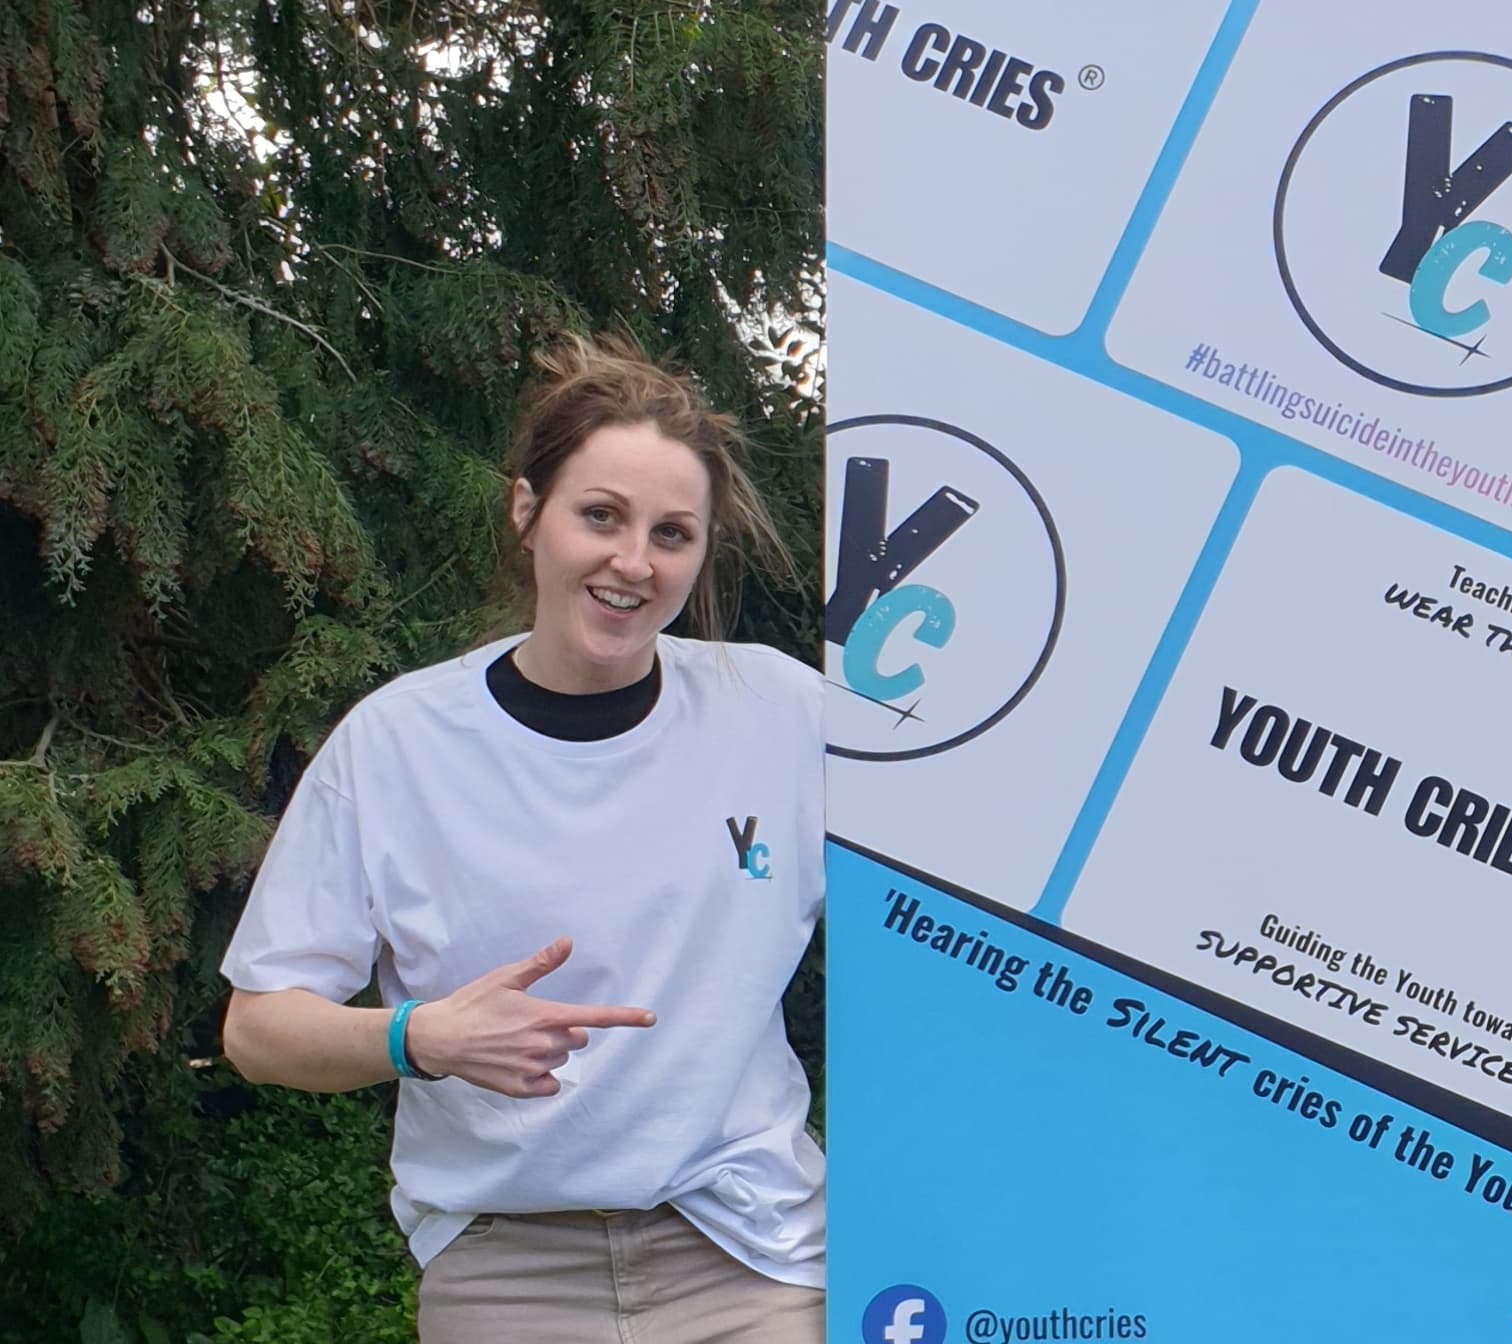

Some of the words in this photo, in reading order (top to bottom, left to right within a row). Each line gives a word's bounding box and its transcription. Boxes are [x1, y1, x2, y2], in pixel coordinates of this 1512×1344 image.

[901, 22, 1065, 130] CRIES
[1384, 583, 1473, 638] WEAR
[1209, 686, 1402, 817] YOUTH
[1196, 929, 1389, 1025] SUPPORTIVE
[1260, 913, 1346, 972] Guiding
[1351, 952, 1388, 986] the
[1394, 968, 1459, 1016] Youth
[882, 889, 1029, 992] 'Hearing
[1031, 961, 1094, 1016] the
[1106, 998, 1251, 1078] SILENT
[1252, 1068, 1342, 1128] cries
[1348, 1113, 1394, 1150] of
[1394, 1126, 1455, 1180] the
